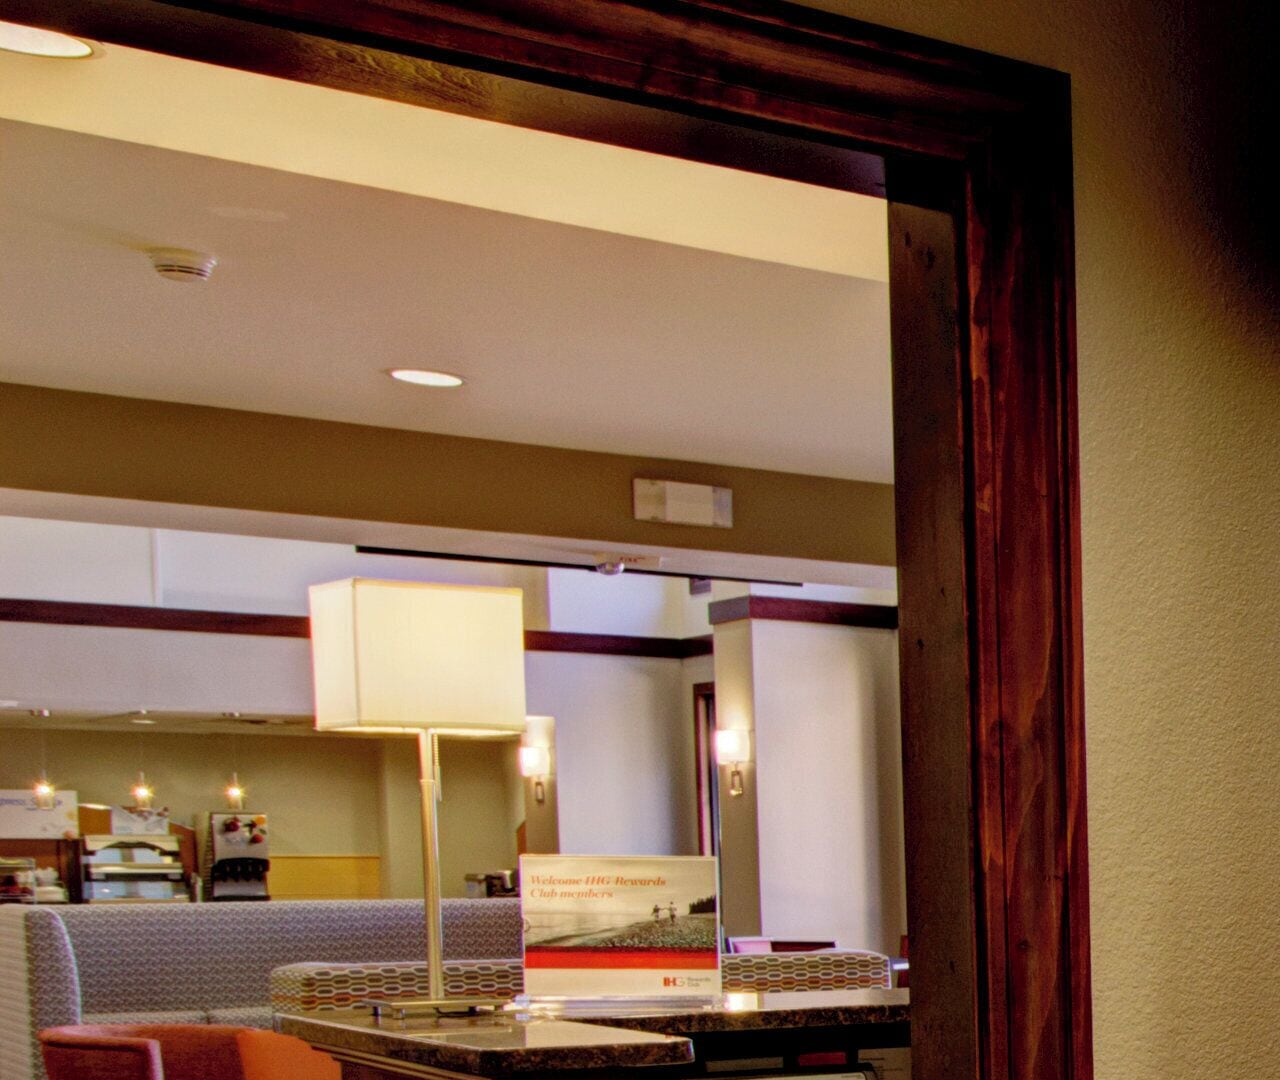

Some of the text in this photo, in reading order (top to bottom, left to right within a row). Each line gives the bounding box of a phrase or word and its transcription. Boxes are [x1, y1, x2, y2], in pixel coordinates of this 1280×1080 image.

[530, 875, 667, 886] Welcome IHG Rewards
[530, 889, 614, 898] Club members
